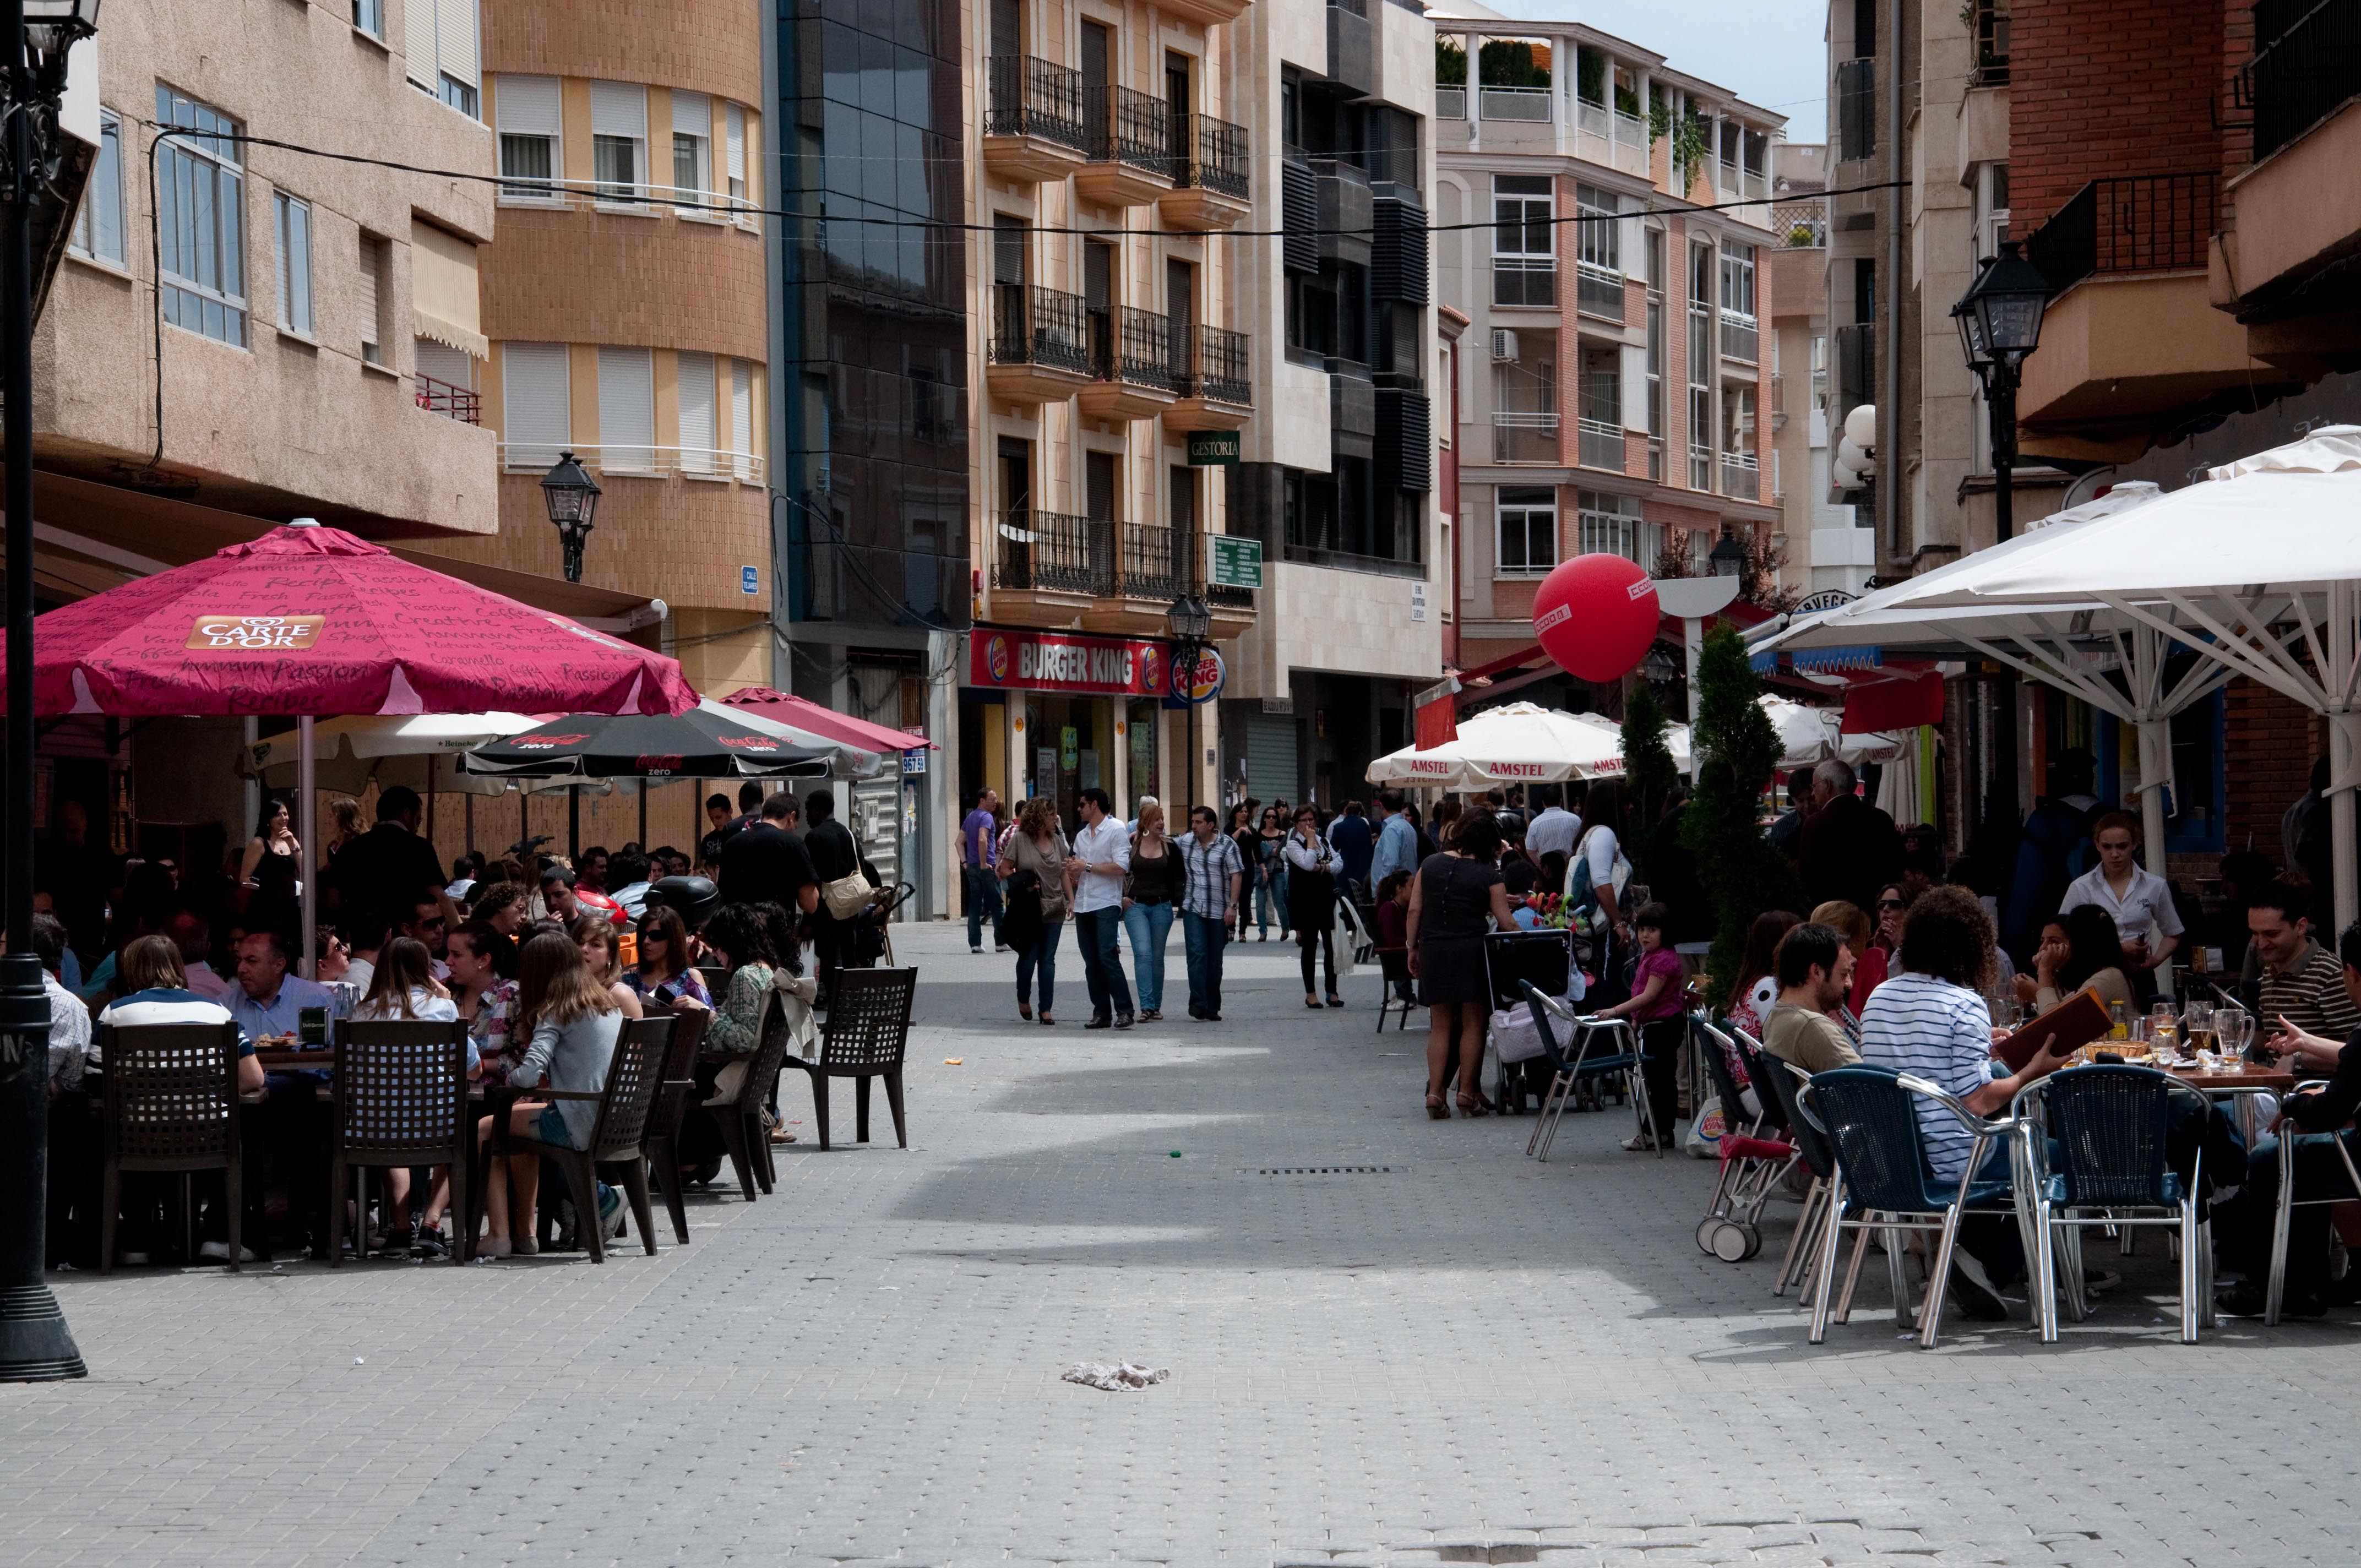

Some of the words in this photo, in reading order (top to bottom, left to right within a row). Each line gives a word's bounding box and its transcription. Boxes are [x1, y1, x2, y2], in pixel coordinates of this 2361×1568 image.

[1192, 442, 1238, 456] GESTORIA
[264, 576, 349, 589] Recipe
[350, 572, 437, 584] Passion
[746, 571, 757, 580] CALLE
[238, 591, 289, 600] Fresh
[357, 598, 389, 607] resh
[397, 601, 463, 611] Passion
[394, 612, 501, 627] Creative
[475, 607, 535, 620] Coffee
[201, 624, 311, 639] CARTE
[326, 631, 382, 644] Spag
[208, 636, 296, 648] D'OR
[110, 645, 185, 660] Coffee
[431, 653, 505, 666] Caramello
[272, 658, 368, 681] Passion
[1019, 642, 1087, 682] BURGER
[1090, 647, 1133, 685] KING
[1174, 658, 1216, 678] BGER
[126, 670, 182, 689] Fresh
[561, 662, 624, 683] Passion
[1176, 668, 1217, 692] KNG
[491, 676, 565, 703] Passion
[227, 686, 324, 714] Recipes
[1872, 747, 1895, 760] AMSTEL
[648, 767, 671, 776] zero
[903, 758, 916, 772] 967
[917, 757, 923, 771] 59
[1410, 760, 1449, 774] AMSTEL
[1489, 762, 1545, 776] AMSTEL
